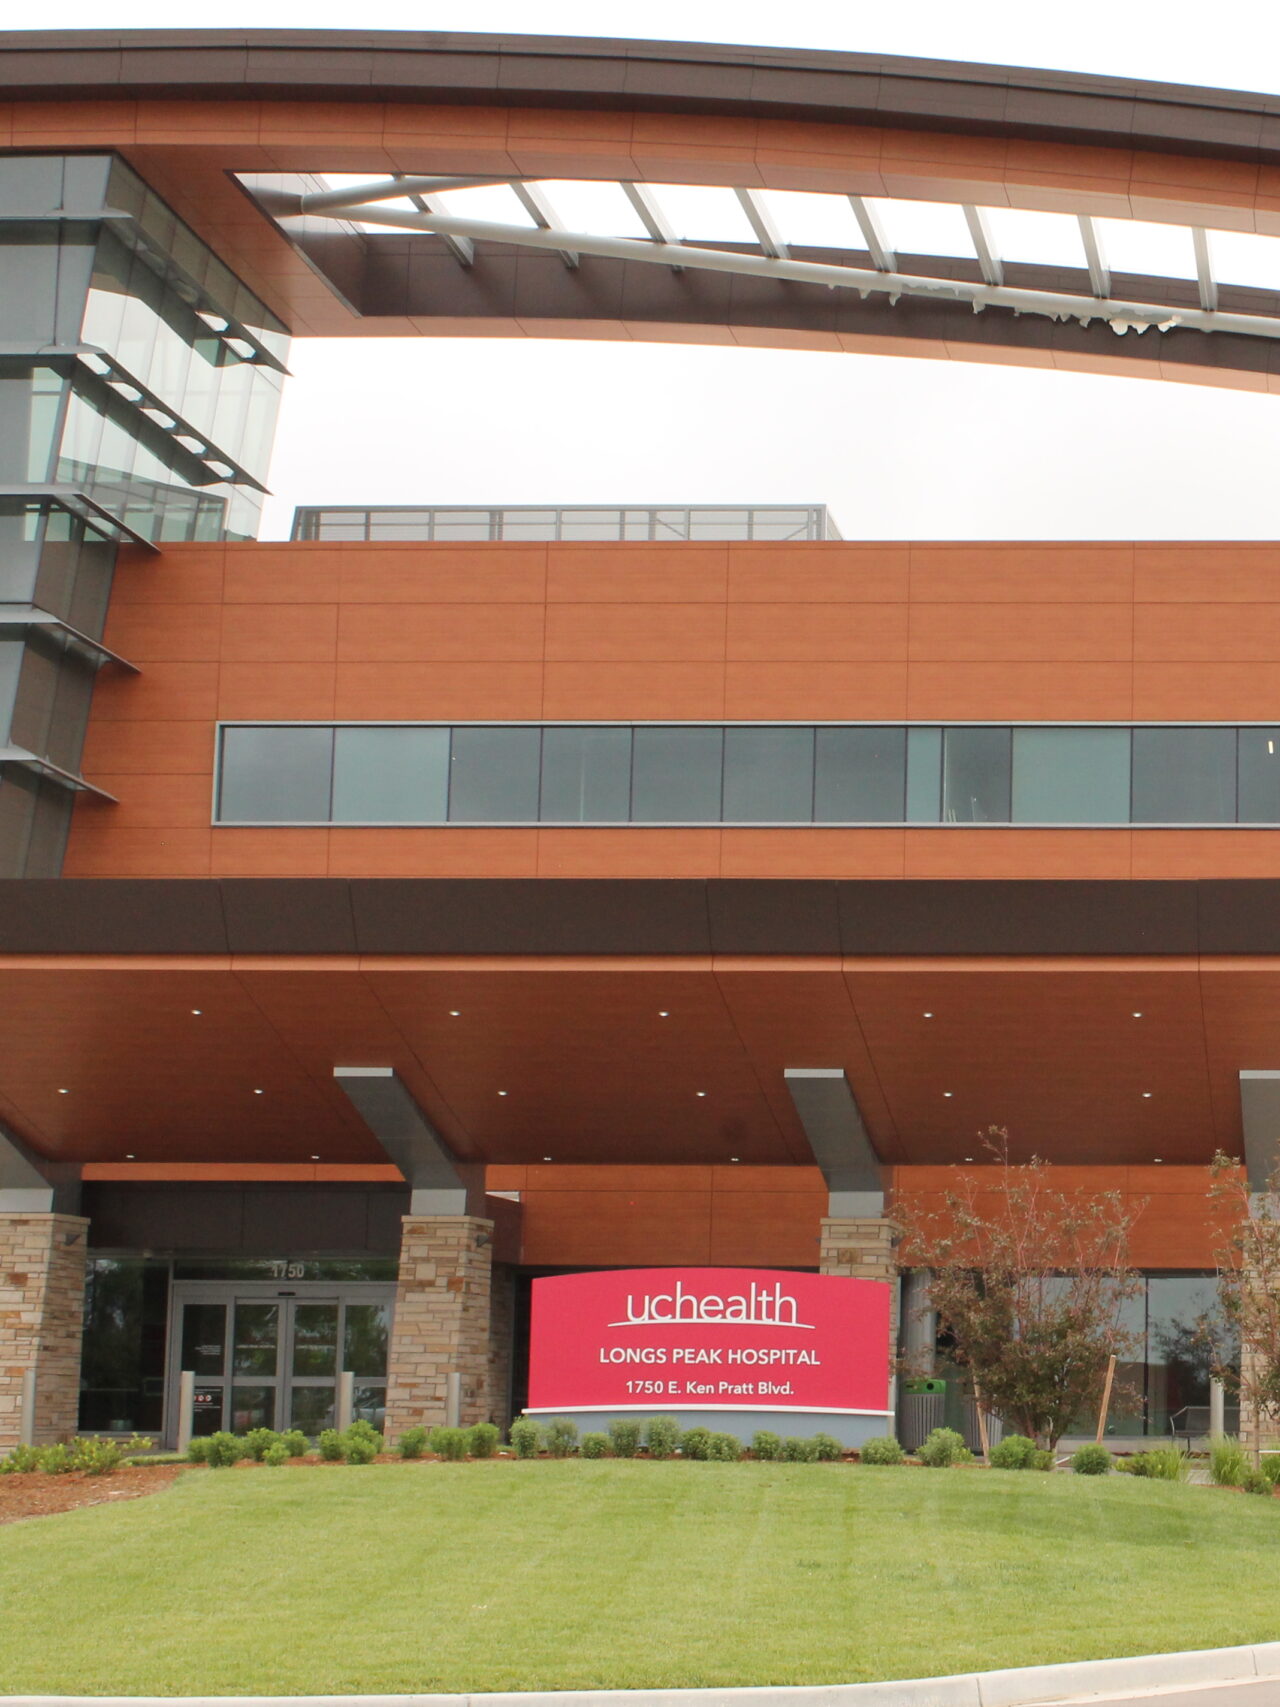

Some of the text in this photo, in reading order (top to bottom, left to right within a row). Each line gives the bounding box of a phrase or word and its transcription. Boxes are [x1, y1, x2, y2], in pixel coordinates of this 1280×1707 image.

[271, 1263, 305, 1278] 1750
[626, 1281, 798, 1324] uchealth
[600, 1347, 820, 1365] LONGS PEAK HOSPITAL
[626, 1380, 794, 1395] 1750 E. Ken Pratt Blvd.
